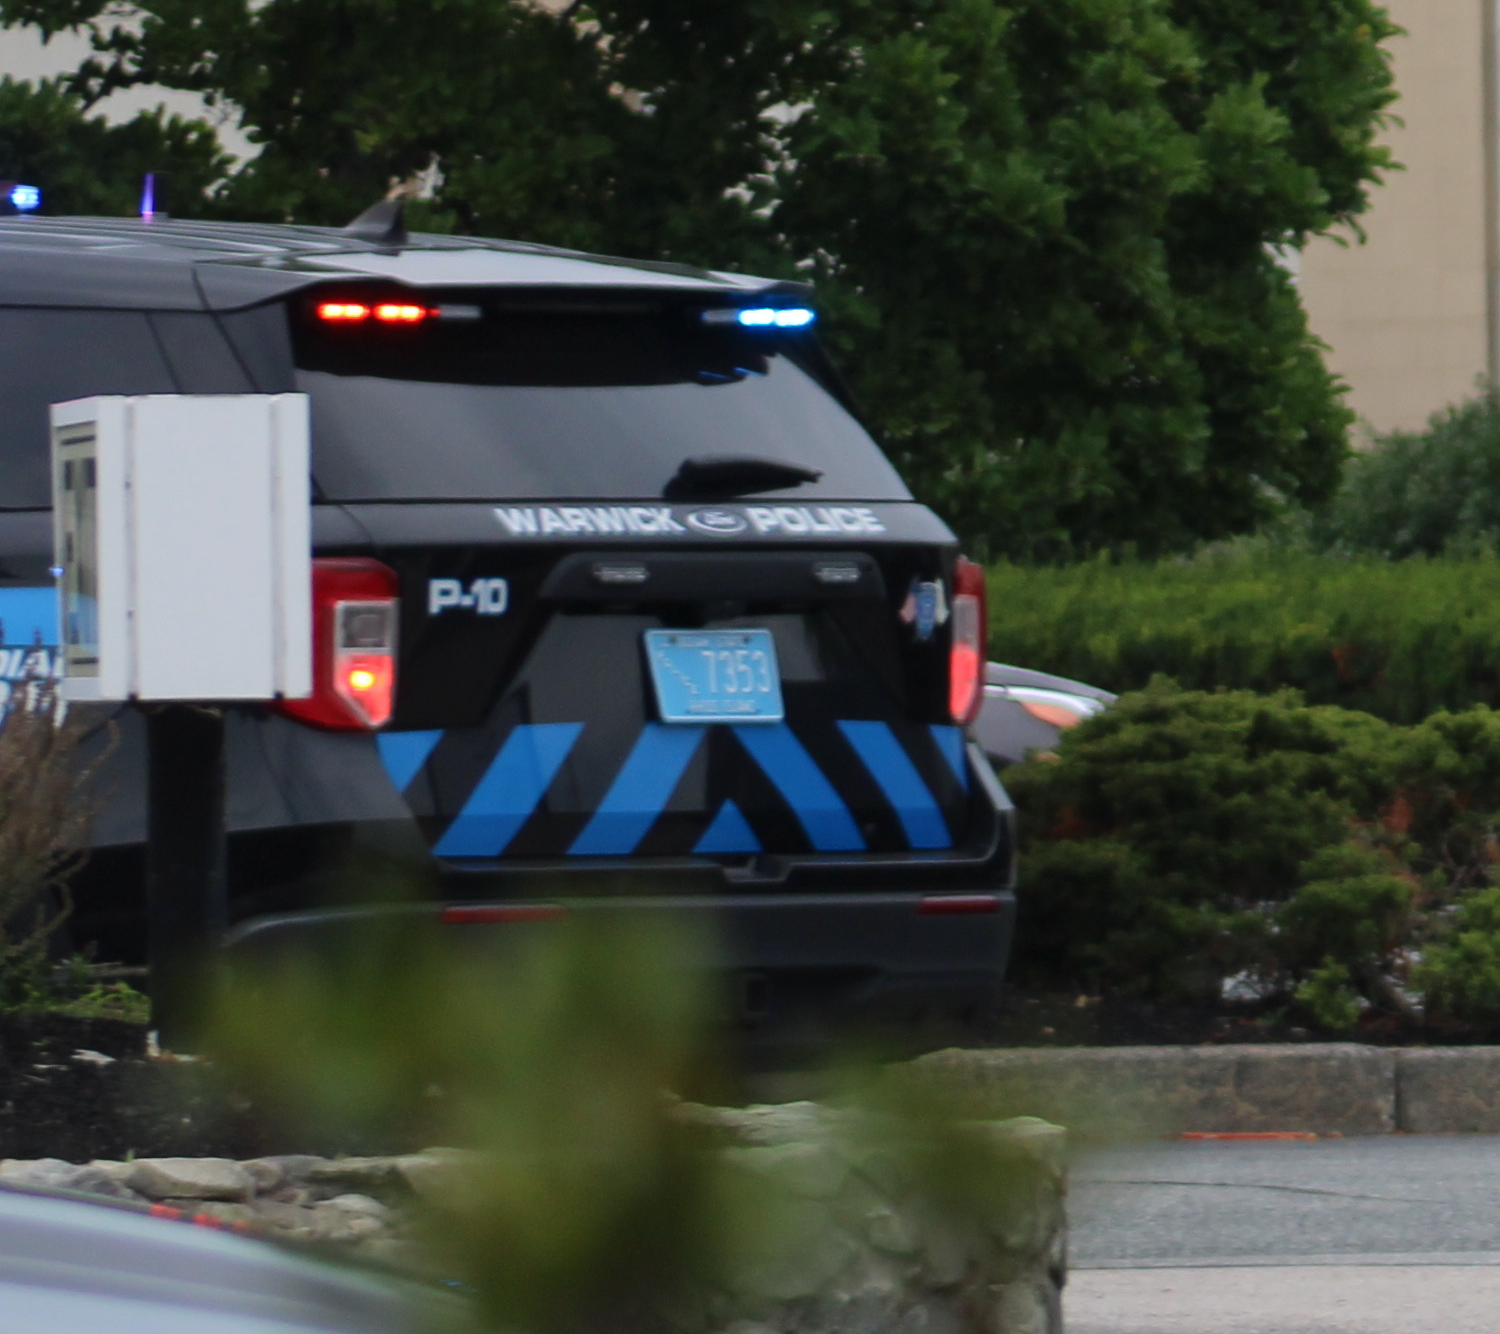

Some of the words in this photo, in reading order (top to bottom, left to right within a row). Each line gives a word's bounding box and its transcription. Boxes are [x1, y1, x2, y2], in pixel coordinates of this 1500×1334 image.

[494, 507, 687, 534] WARWICK
[744, 507, 887, 534] POLICE
[427, 578, 509, 615] P-10
[701, 649, 771, 695] 7353
